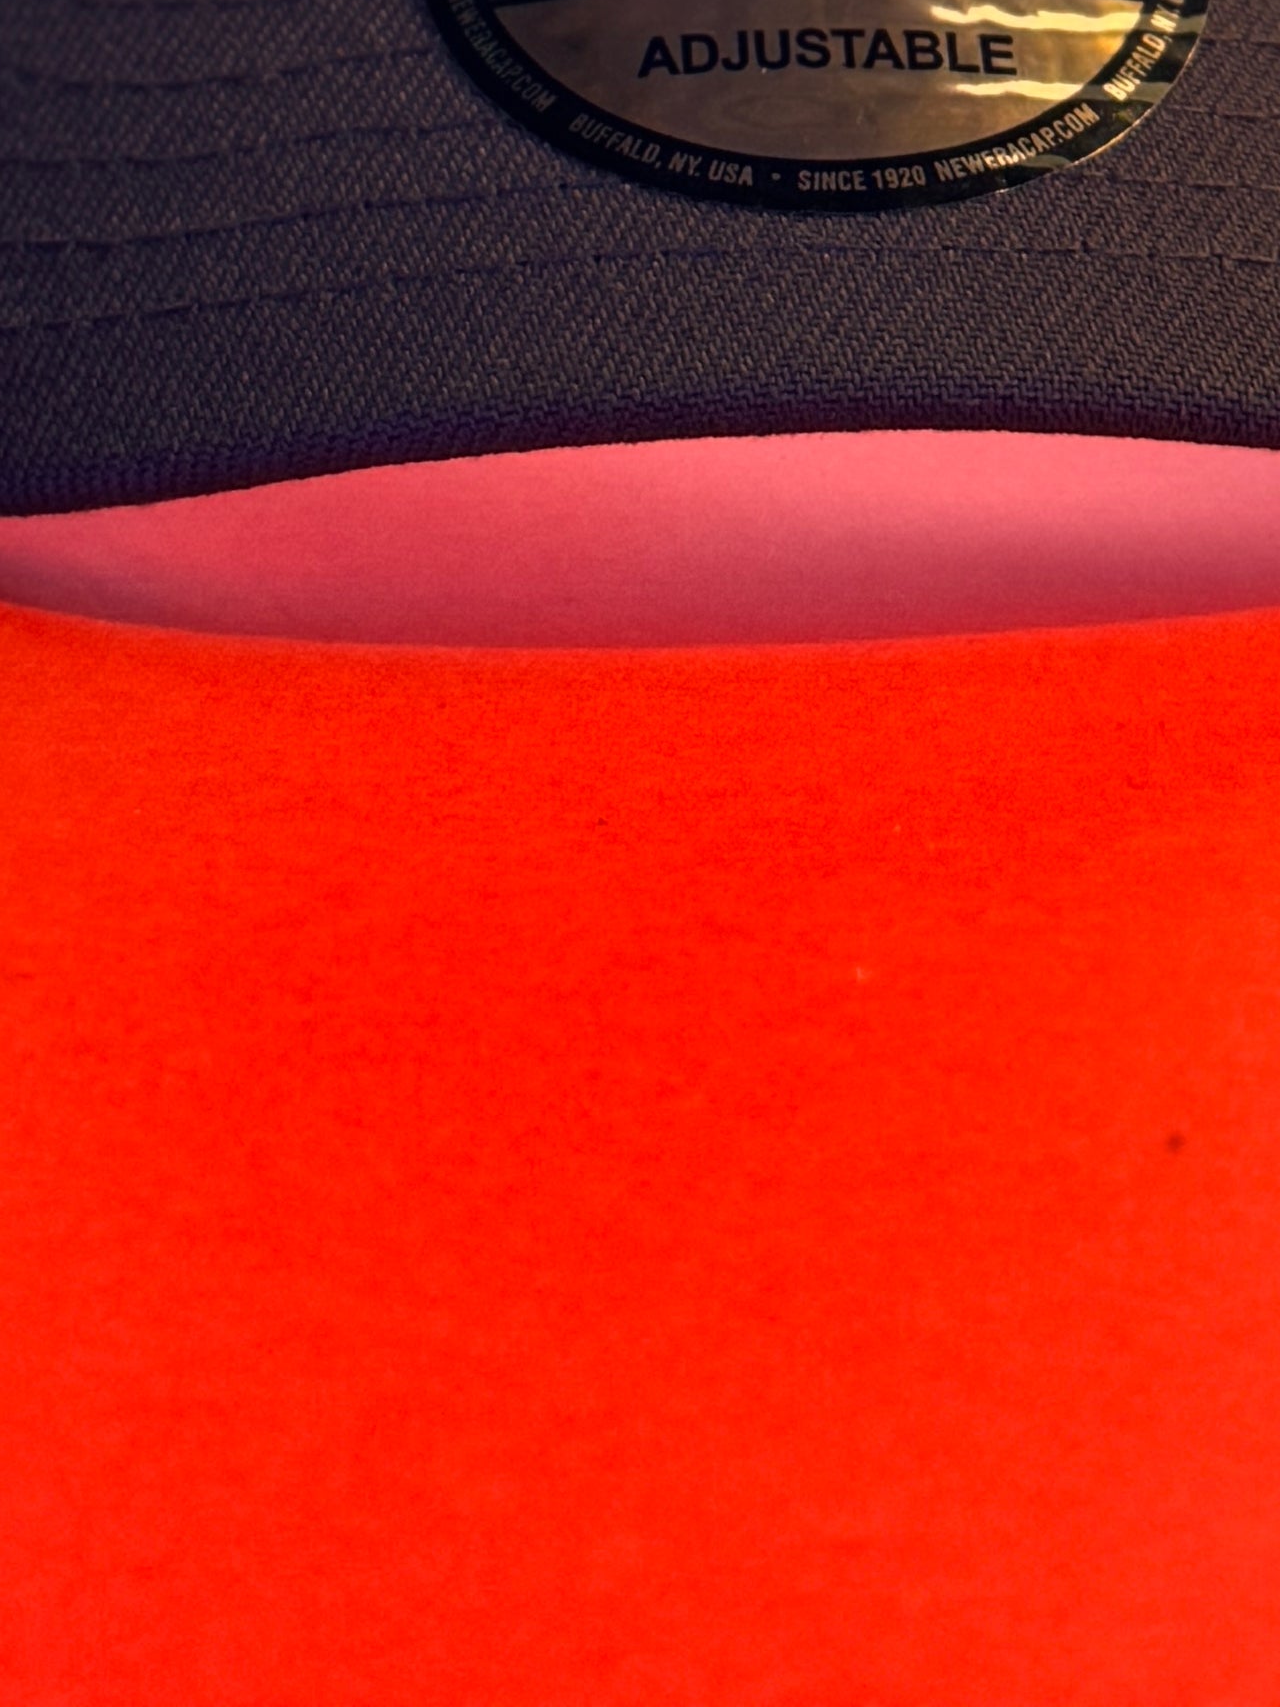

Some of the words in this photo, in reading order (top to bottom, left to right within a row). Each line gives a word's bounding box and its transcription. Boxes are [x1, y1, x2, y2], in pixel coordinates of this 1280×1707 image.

[637, 28, 1019, 78] ADJUSTABLE
[708, 160, 753, 187] USA
[797, 169, 867, 191] SINCE
[872, 166, 926, 190] 1920
[933, 102, 1101, 183] NEWERACAP.COM
